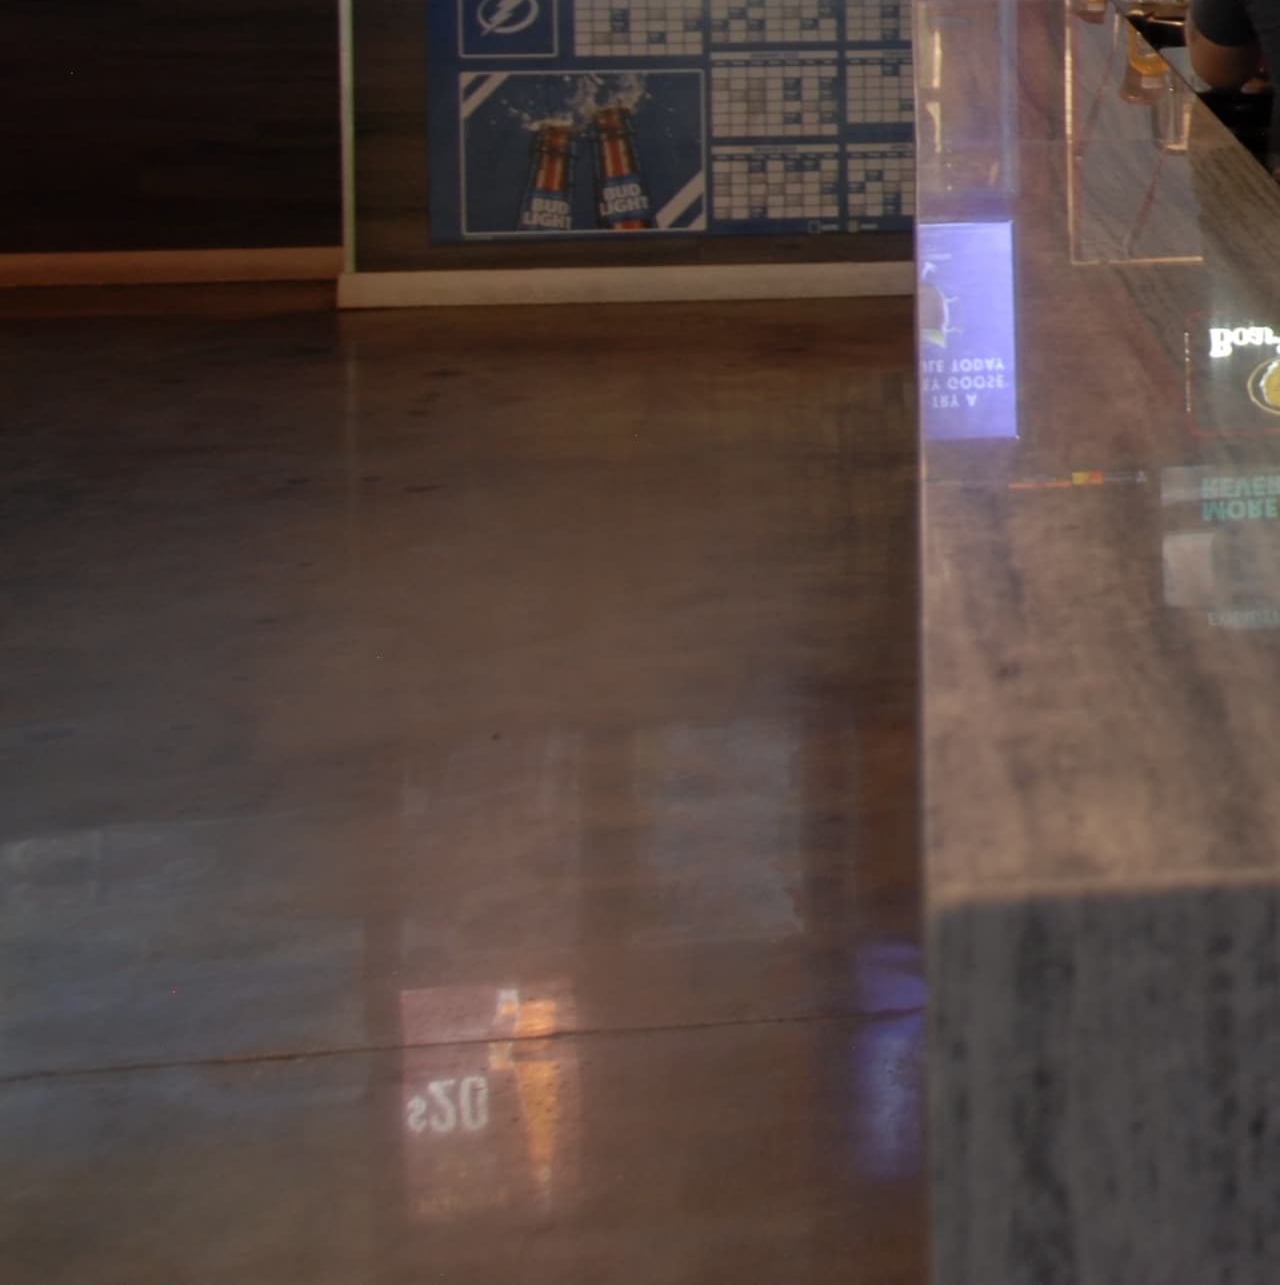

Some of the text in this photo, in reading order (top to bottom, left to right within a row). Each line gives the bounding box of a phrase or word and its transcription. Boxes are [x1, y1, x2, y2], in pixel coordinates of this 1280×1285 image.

[603, 183, 642, 202] BUD
[530, 198, 569, 213] BUD
[600, 196, 649, 216] LIGHT
[522, 211, 573, 230] LIGHT
